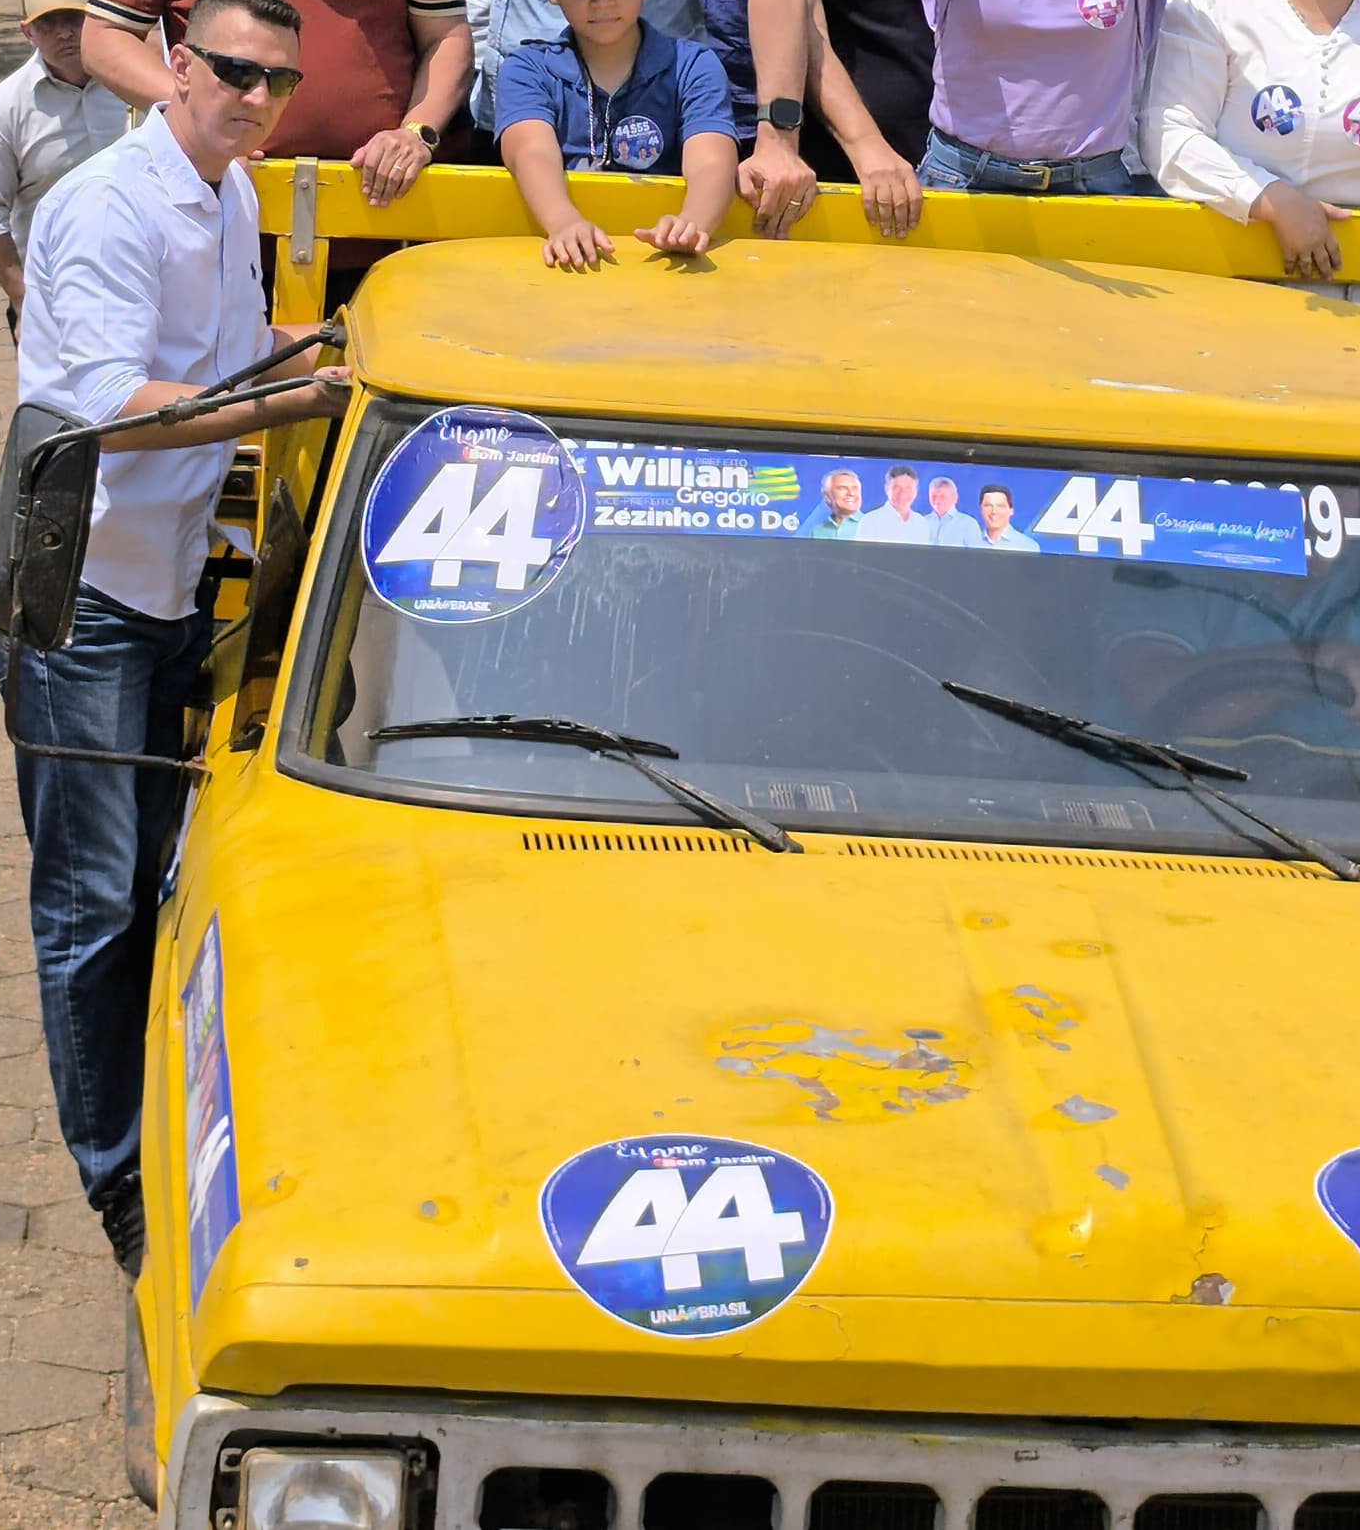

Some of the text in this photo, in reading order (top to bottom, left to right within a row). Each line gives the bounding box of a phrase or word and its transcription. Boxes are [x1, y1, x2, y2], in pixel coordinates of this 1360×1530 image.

[1256, 86, 1293, 120] 44
[506, 451, 560, 465] Jardim
[596, 456, 750, 489] Willian
[676, 486, 770, 508] Gregório
[375, 463, 552, 591] 44
[716, 509, 755, 529] do
[1033, 476, 1155, 555] 44
[1155, 512, 1215, 533] Coragem
[1217, 523, 1252, 536] para
[652, 1143, 708, 1157] amo
[711, 1155, 776, 1165] Jardim
[576, 1165, 806, 1292] 44
[699, 1301, 752, 1319] BRASIL
